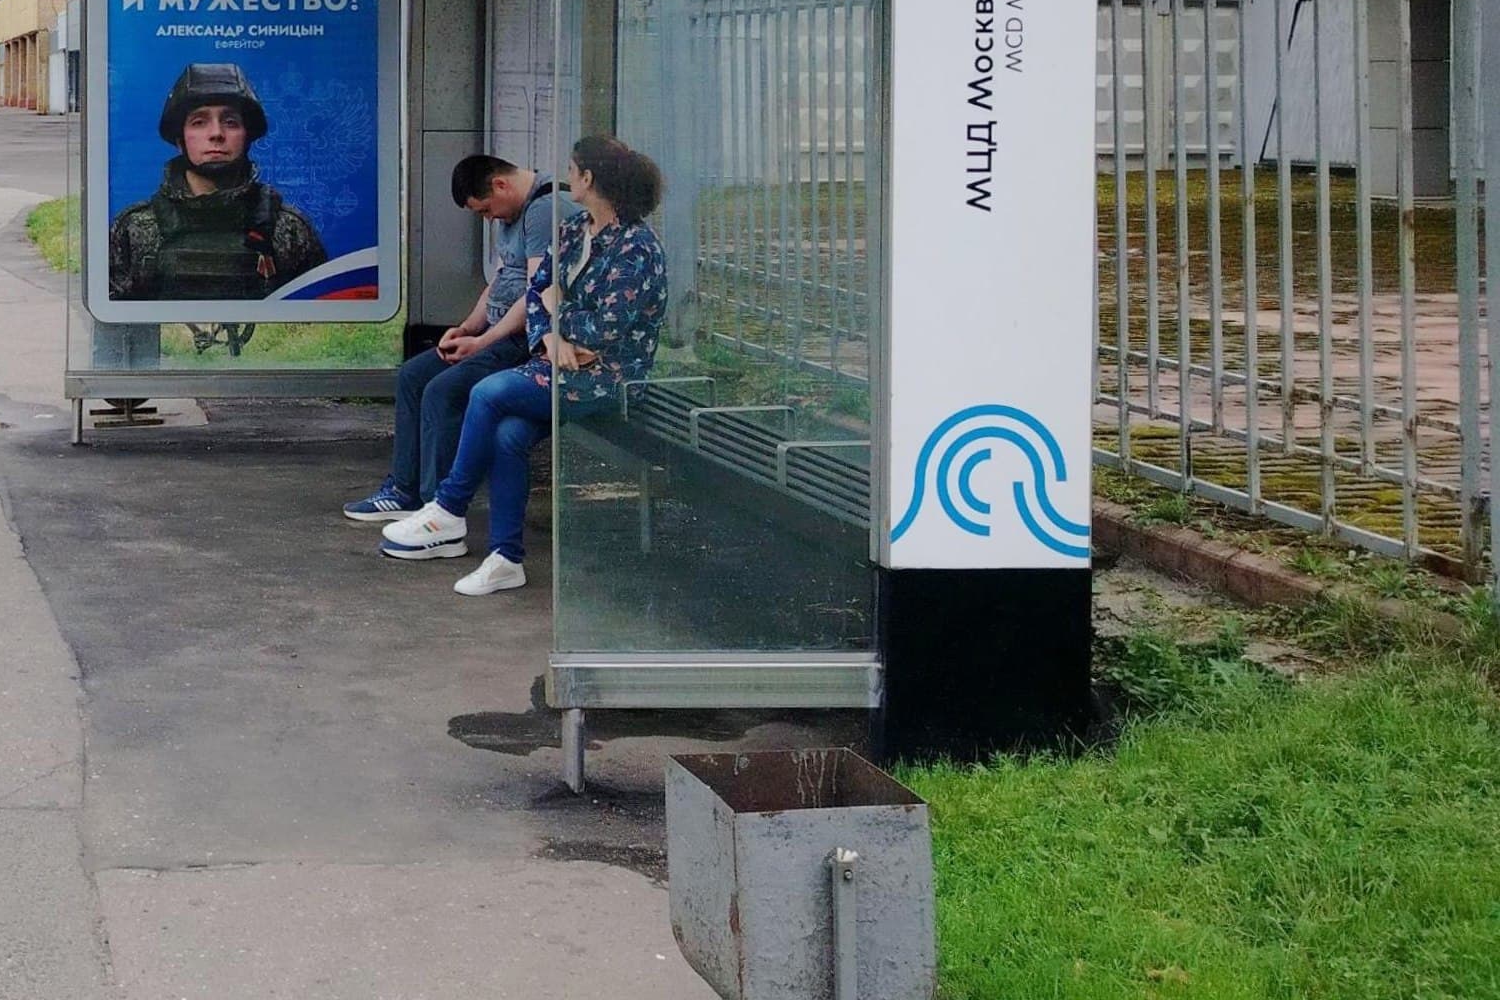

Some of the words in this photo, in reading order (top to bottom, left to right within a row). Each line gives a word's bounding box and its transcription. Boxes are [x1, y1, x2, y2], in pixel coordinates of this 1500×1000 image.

[156, 24, 245, 38] АЛЕКСАНДР
[248, 24, 325, 38] СИНИЦЫН
[215, 38, 266, 50] ЕФРЕЙТОР
[1005, 17, 1025, 73] MCD
[965, 120, 998, 213] МЦД
